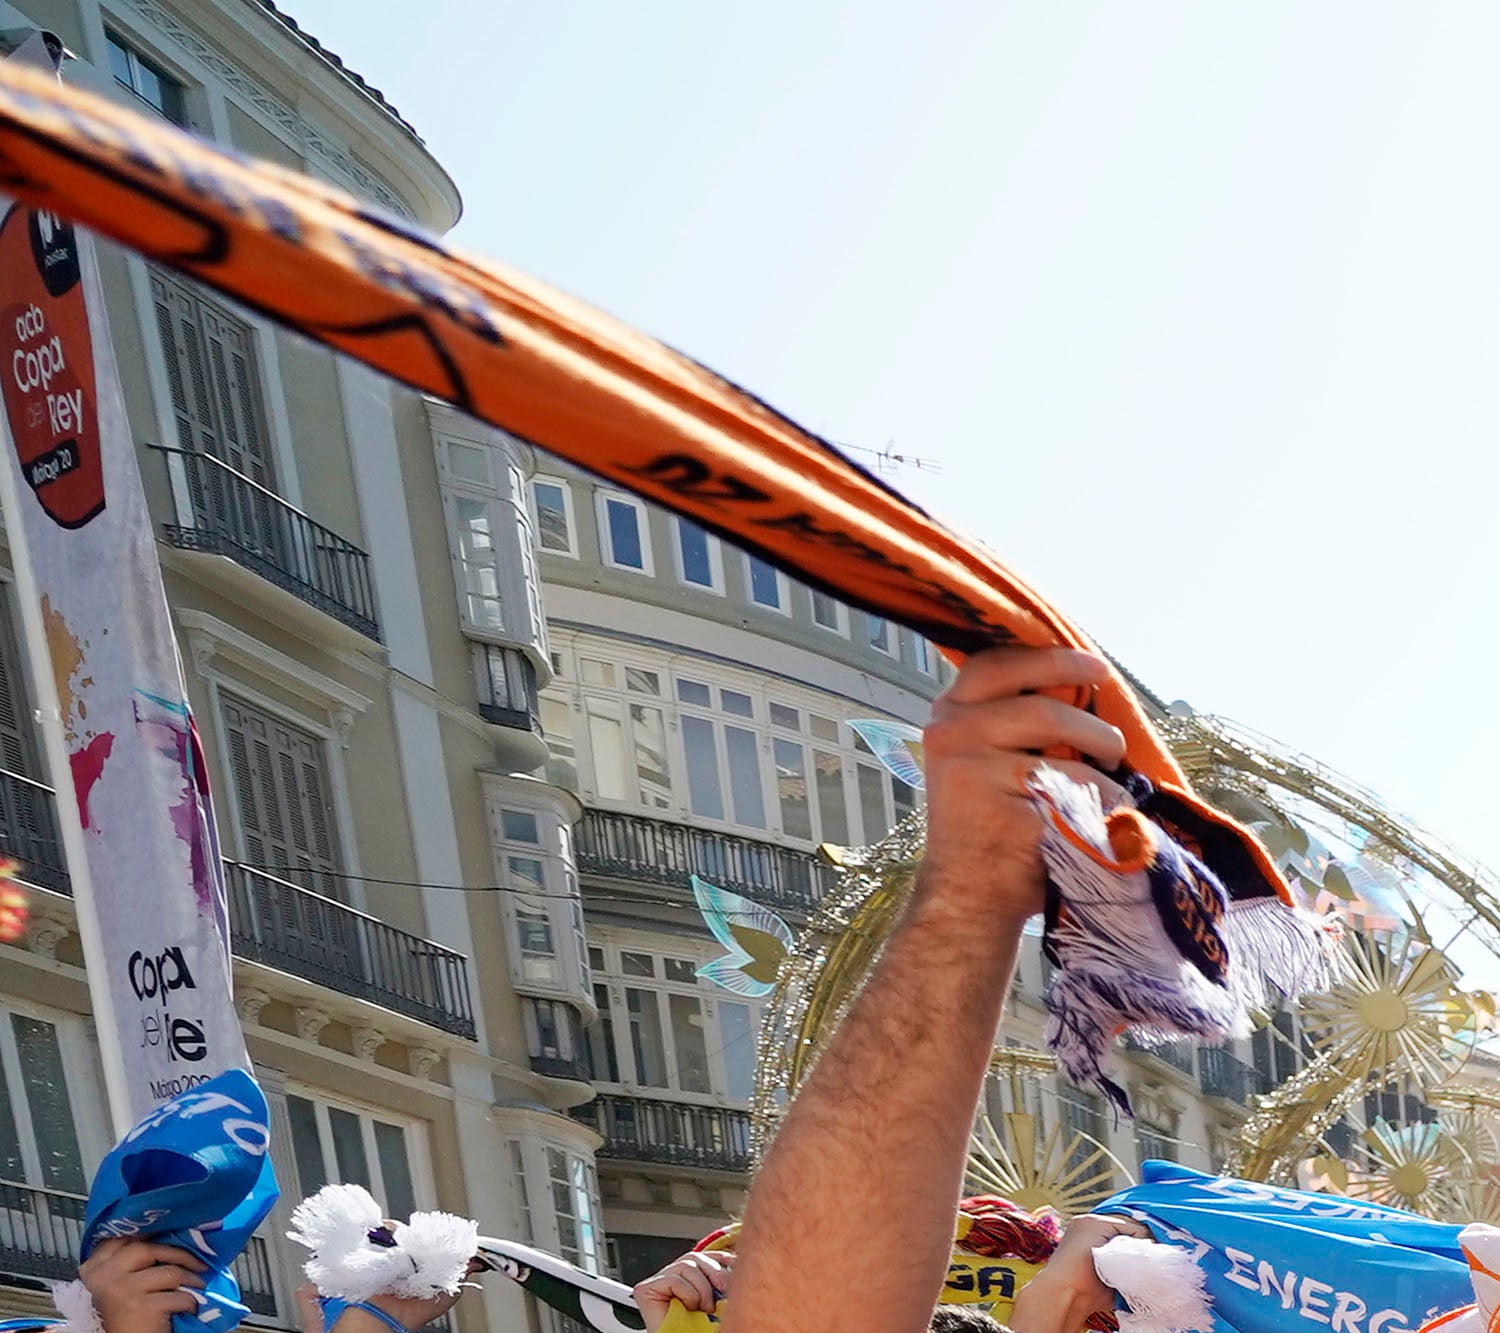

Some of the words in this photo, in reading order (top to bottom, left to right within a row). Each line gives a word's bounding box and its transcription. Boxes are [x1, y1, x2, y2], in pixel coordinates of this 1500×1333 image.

[16, 304, 44, 342] acb
[13, 335, 65, 393] Copa
[47, 388, 84, 436] Rey
